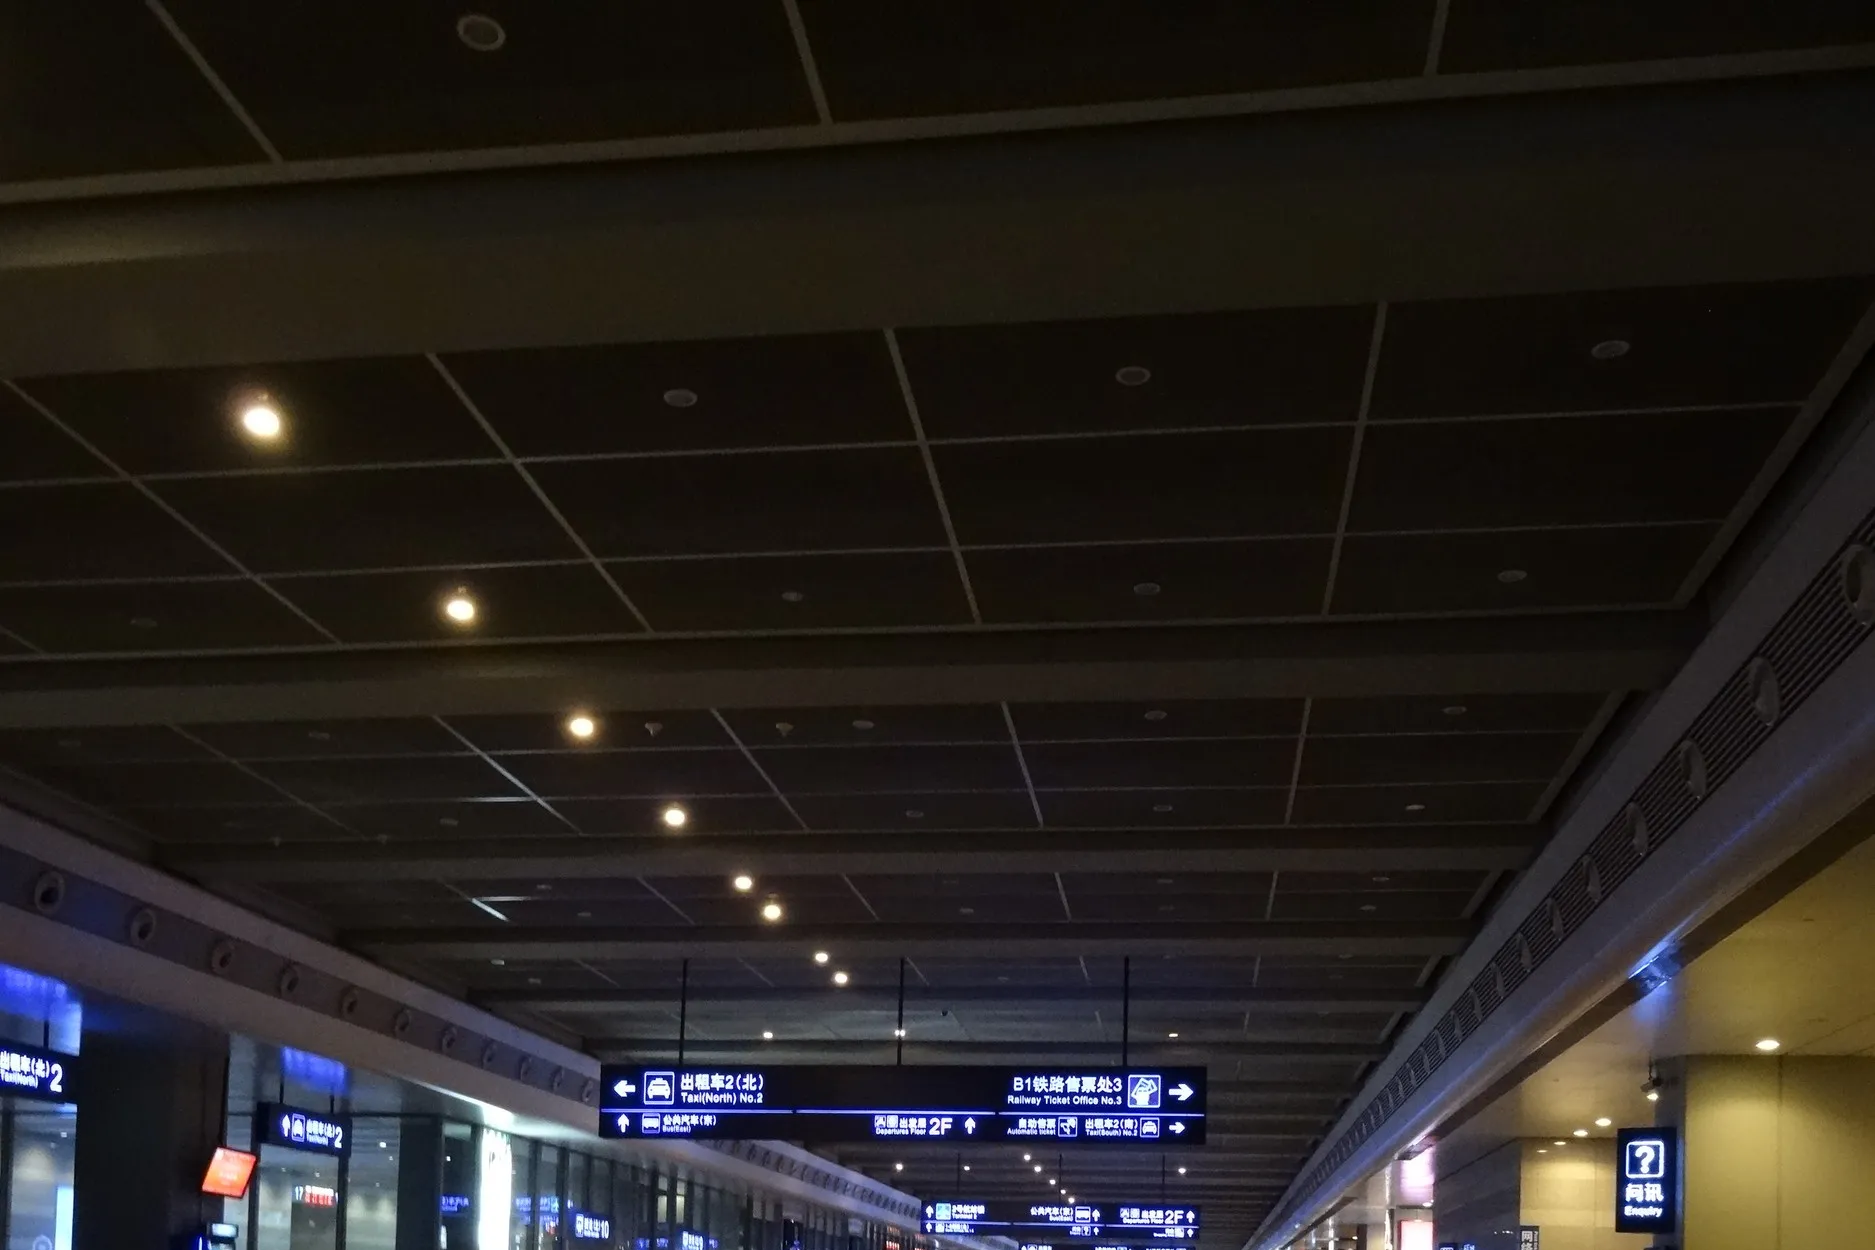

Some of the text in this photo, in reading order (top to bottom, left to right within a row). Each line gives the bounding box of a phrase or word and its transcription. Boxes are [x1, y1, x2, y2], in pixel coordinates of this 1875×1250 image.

[50, 1063, 63, 1093] 2
[680, 1073, 764, 1091] 出租车2(北)
[1013, 1075, 1122, 1093] B1铁路售票处3
[680, 1092, 763, 1105] Taxi(North) No.2
[1007, 1095, 1122, 1106] Railway Ticket Office No.3
[929, 1117, 953, 1136] 2F
[334, 1126, 343, 1149] 2
[1625, 1182, 1664, 1203] 问讯
[1164, 1210, 1184, 1225] 2F
[1624, 1205, 1664, 1218] Enquiry
